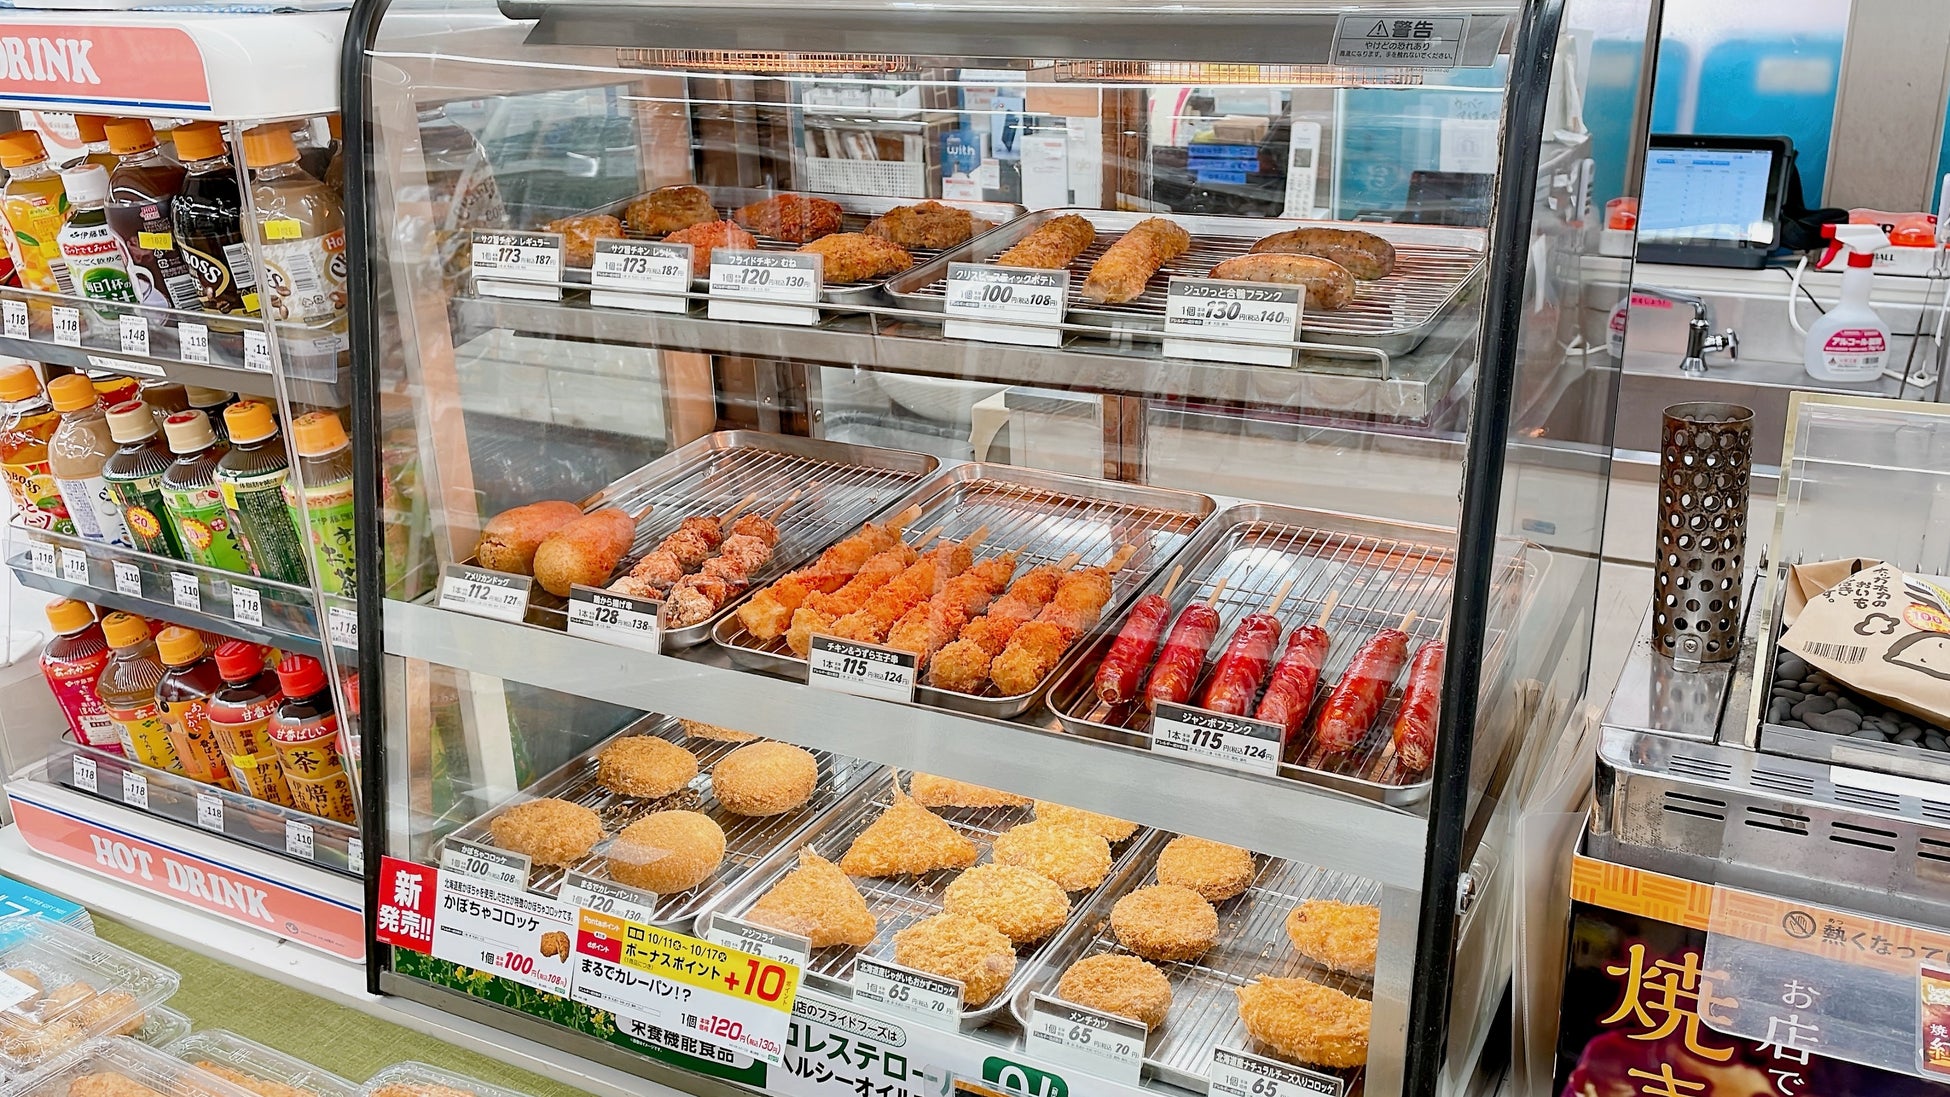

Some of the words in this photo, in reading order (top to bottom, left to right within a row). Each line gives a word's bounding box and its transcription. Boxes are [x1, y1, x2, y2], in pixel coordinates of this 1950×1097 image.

[1392, 20, 1433, 38] 警告
[183, 249, 221, 283] BOSS
[729, 256, 778, 267] フライドチキン
[781, 258, 796, 268] むね
[11, 313, 26, 326] 118
[61, 319, 78, 332] 118
[128, 328, 146, 341] 148
[190, 336, 207, 347] 118
[12, 474, 41, 494] BOSS
[38, 552, 53, 564] 118
[70, 560, 86, 571] 118
[125, 572, 139, 583] 110
[465, 571, 510, 586] アメリカンドッグ
[183, 585, 198, 596] 110
[241, 599, 258, 611] 118
[339, 621, 356, 634] 118
[827, 642, 899, 664] チキン&うずら玉子串
[1182, 712, 1252, 735] ジャンボフランク
[276, 726, 327, 742] 甘香ばしい
[1167, 729, 1181, 741] 1本
[291, 750, 320, 774] 茶
[81, 767, 94, 779] 118
[131, 784, 145, 796] 118
[206, 806, 222, 818] 118
[297, 834, 312, 845] 110
[461, 845, 508, 864] かぼちゃコロッケ
[90, 834, 153, 881] HOT
[163, 857, 275, 924] DRINK
[393, 869, 422, 910] 新
[444, 894, 540, 932] かぼちゃコロッケ
[378, 904, 431, 942] 発売!!
[741, 927, 775, 944] アジフライ
[480, 950, 494, 965] 1個
[626, 943, 721, 981] ボーナスポイント
[725, 958, 786, 1002] +10
[681, 1013, 697, 1029] 1個
[1069, 1011, 1109, 1029] メンチカツ
[1755, 980, 1820, 1097] お店で
[1216, 1051, 1335, 1094] 北海道産ナチュラルチーズ入りコロッケ
